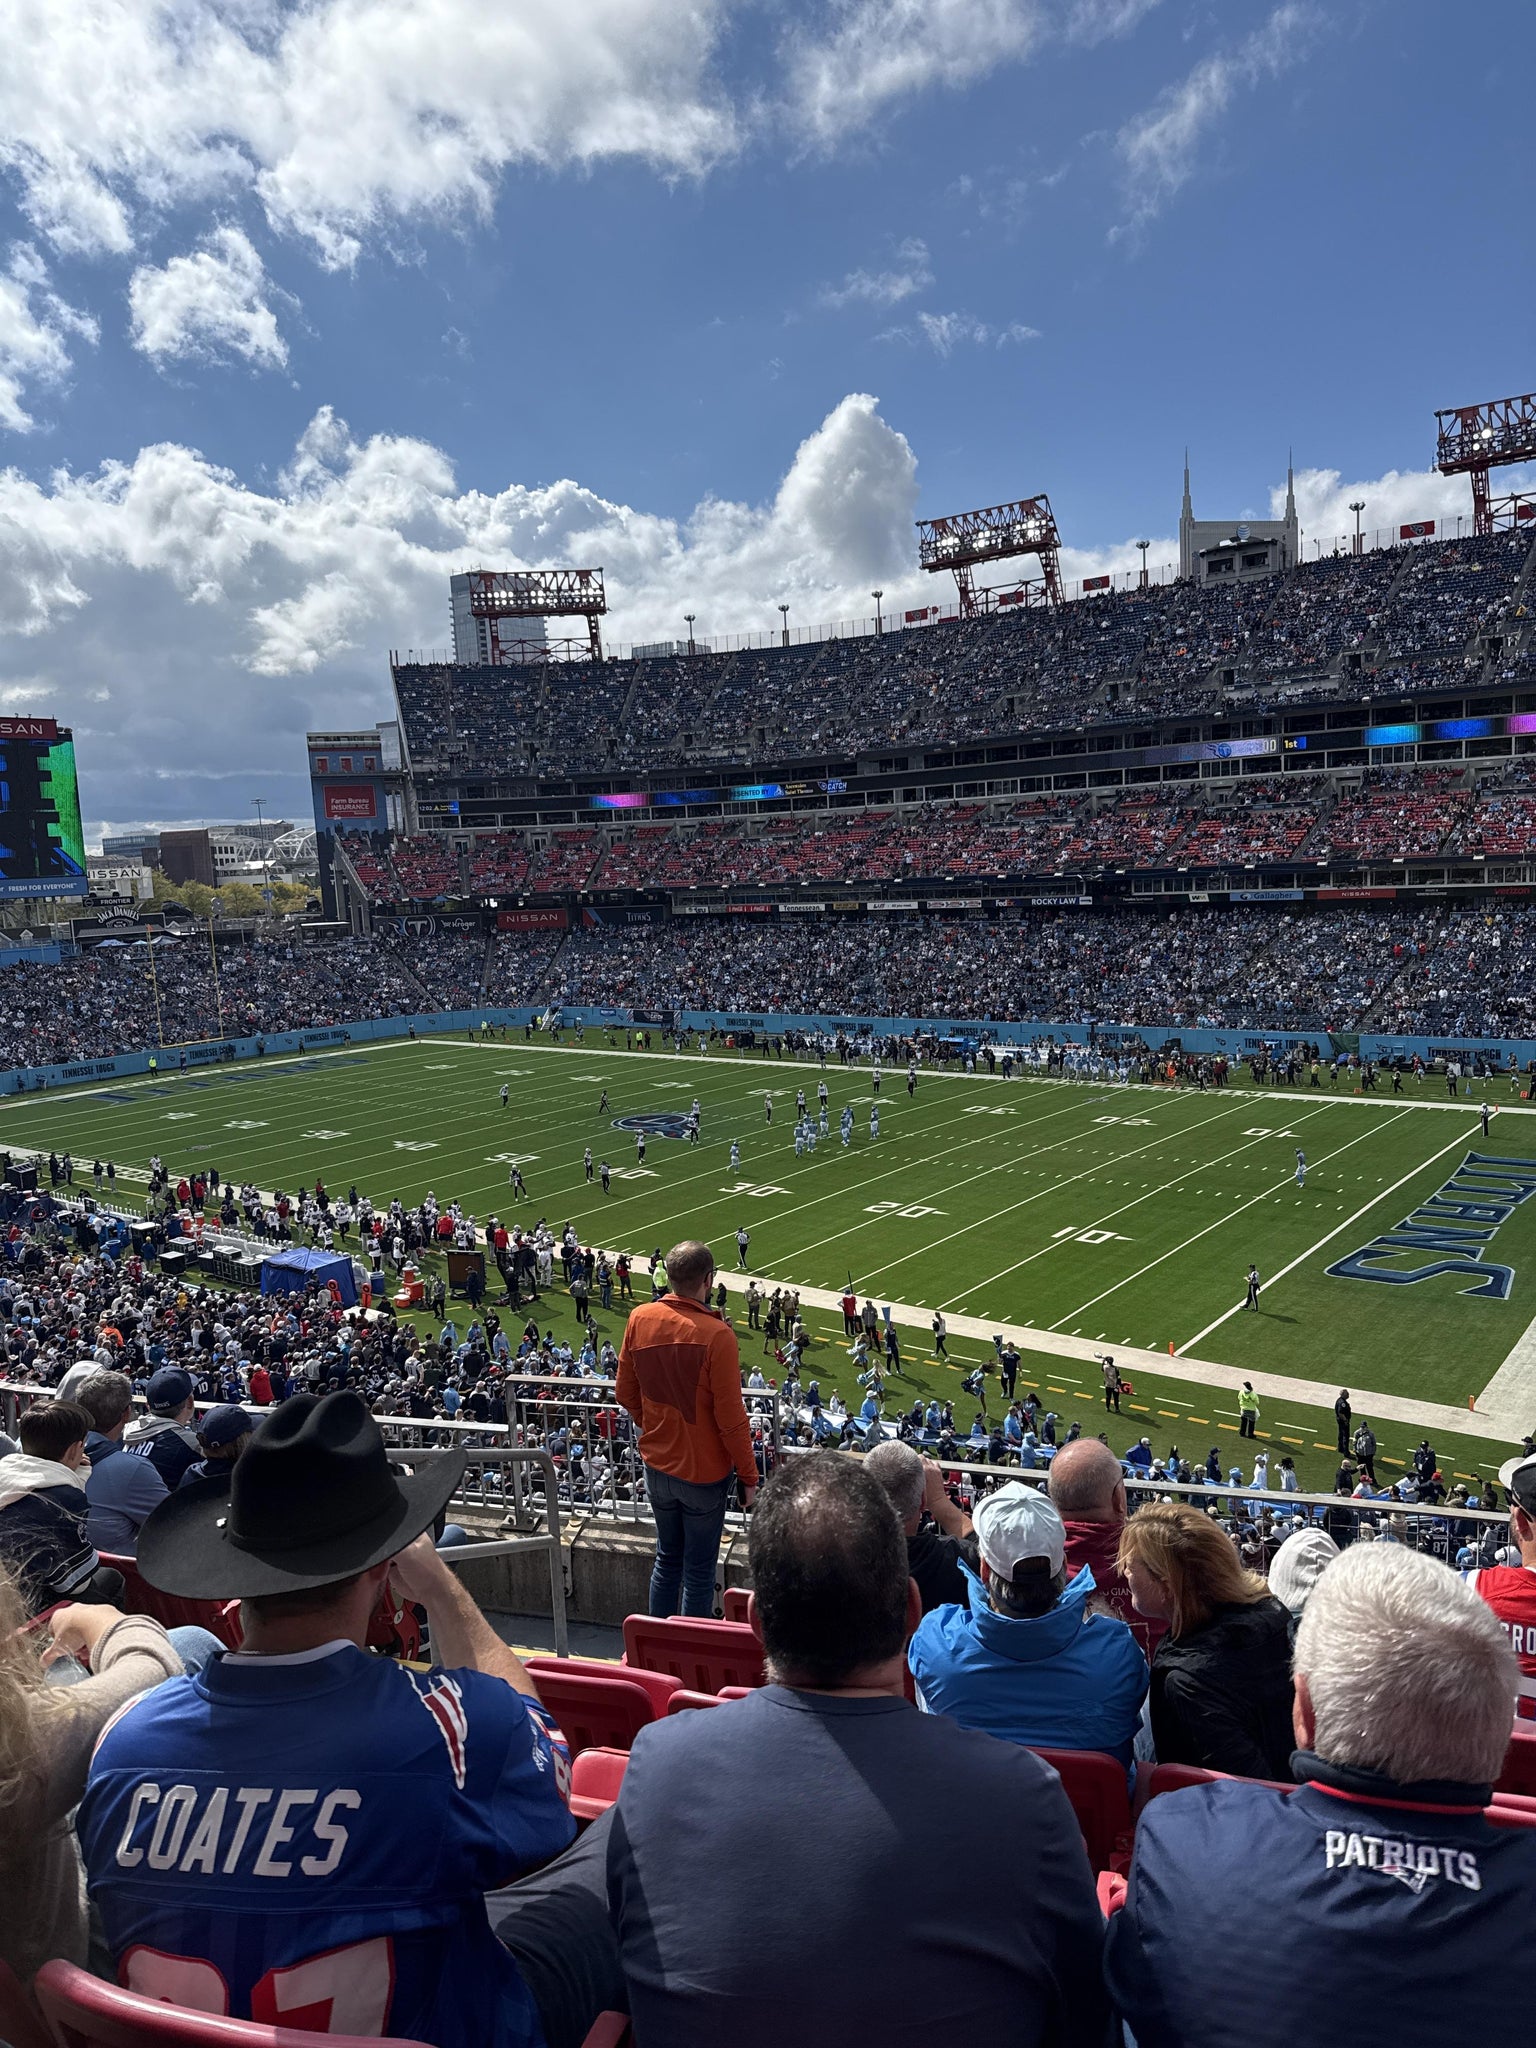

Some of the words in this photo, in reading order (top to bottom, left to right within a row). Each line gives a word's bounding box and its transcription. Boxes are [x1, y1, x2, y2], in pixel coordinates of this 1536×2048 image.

[1284, 740, 1297, 749] 1st
[1254, 892, 1292, 900] Gallagher
[1494, 887, 1531, 895] verizon
[996, 899, 1015, 907] FedEx
[97, 910, 115, 923] JACK
[506, 914, 558, 922] NISSAN
[626, 912, 652, 921] TITANS
[452, 918, 476, 930] Kroger
[304, 1032, 329, 1043] TENNESSEE
[62, 1065, 94, 1078] TENNESSEE
[485, 1152, 541, 1164] 50
[719, 1183, 784, 1196] 30
[863, 1201, 938, 1218] 20
[1051, 1226, 1120, 1244] 10
[198, 1381, 208, 1394] 10
[1433, 1541, 1447, 1554] 87
[116, 1783, 362, 1877] COATES
[1325, 1830, 1483, 1891] PATRIOTS
